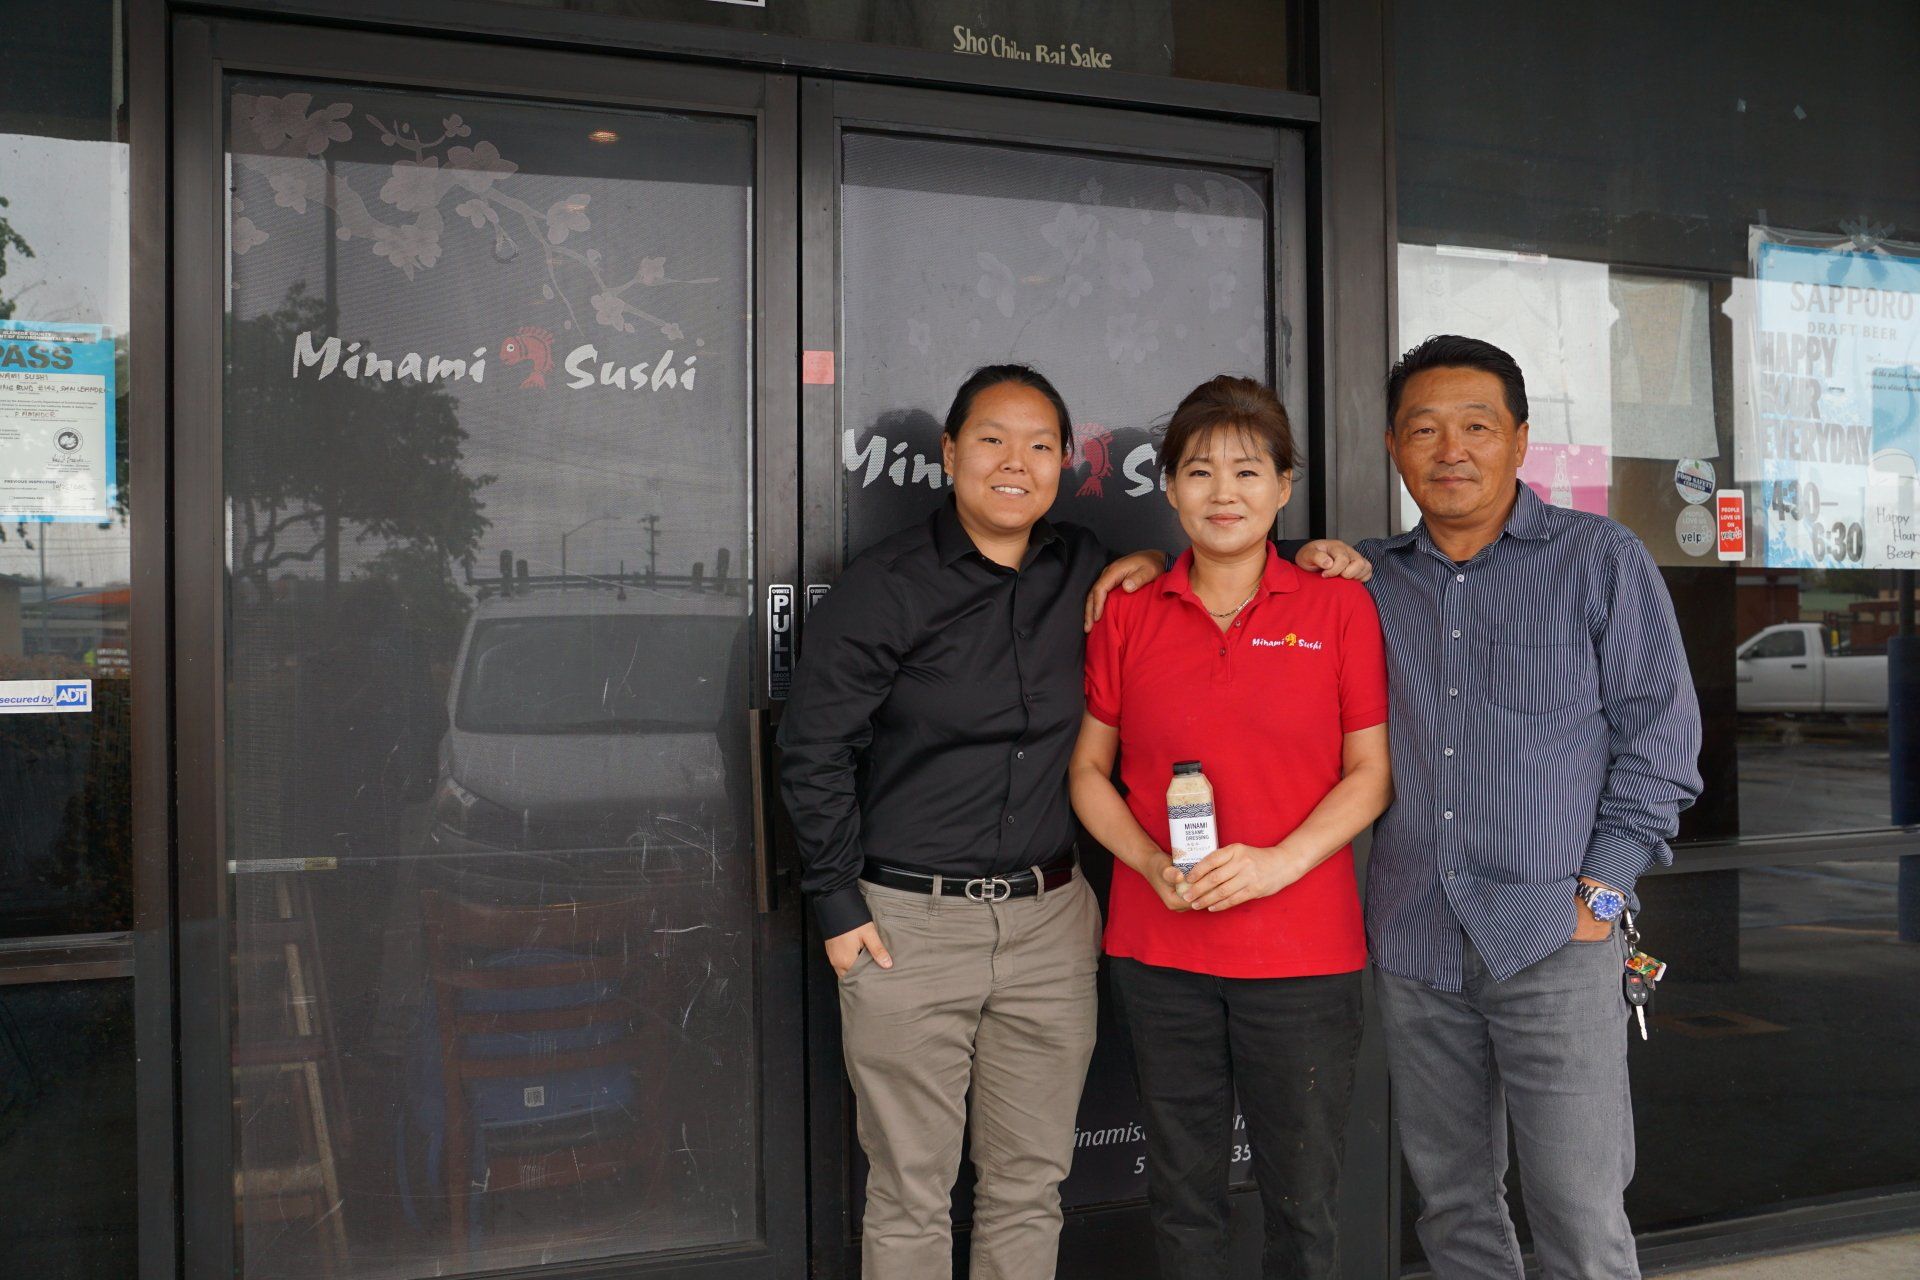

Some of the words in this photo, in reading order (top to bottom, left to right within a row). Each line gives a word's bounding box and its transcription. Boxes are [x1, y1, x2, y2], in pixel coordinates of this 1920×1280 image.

[953, 25, 988, 55] Sho
[1070, 43, 1112, 68] Sake
[1790, 281, 1914, 321] SAPPORO
[1807, 321, 1857, 337] DRAFT
[1862, 325, 1897, 341] BEER
[292, 331, 487, 383] Minami
[564, 344, 698, 392] Sushi
[1760, 330, 1837, 378] HAPPY
[1761, 419, 1872, 466] EVERYDAY
[1876, 506, 1910, 526] Happy
[1681, 531, 1702, 544] yelp
[1811, 521, 1864, 563] 6:30
[772, 594, 790, 672] PULL
[1252, 637, 1285, 647] Minami
[1298, 639, 1323, 650] Sushi
[0, 696, 40, 704] secured
[41, 695, 54, 705] by
[56, 688, 87, 703] ADT
[1184, 822, 1208, 830] MINAMI
